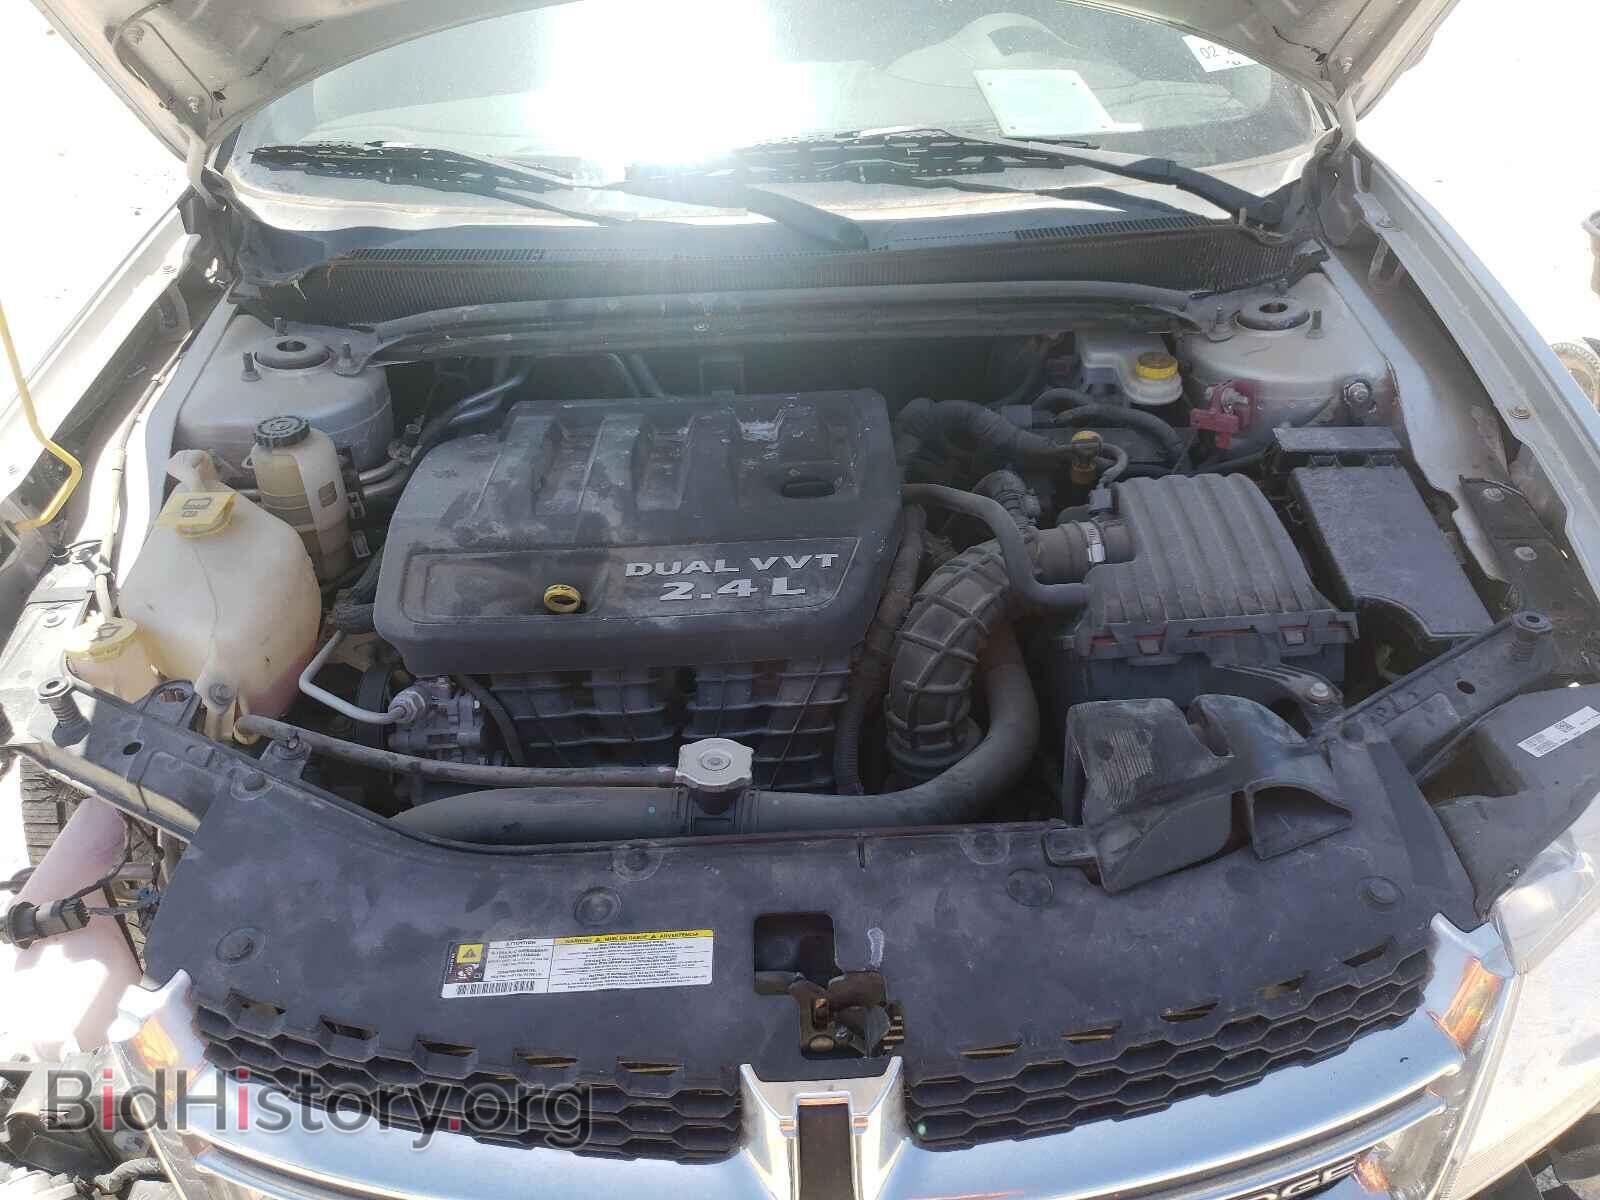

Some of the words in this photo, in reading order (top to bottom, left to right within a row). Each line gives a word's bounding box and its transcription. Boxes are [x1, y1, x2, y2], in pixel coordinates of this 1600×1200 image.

[625, 559, 740, 577] DUAL
[749, 553, 839, 571] VVT
[659, 577, 758, 601] 2.4
[771, 576, 806, 596] L
